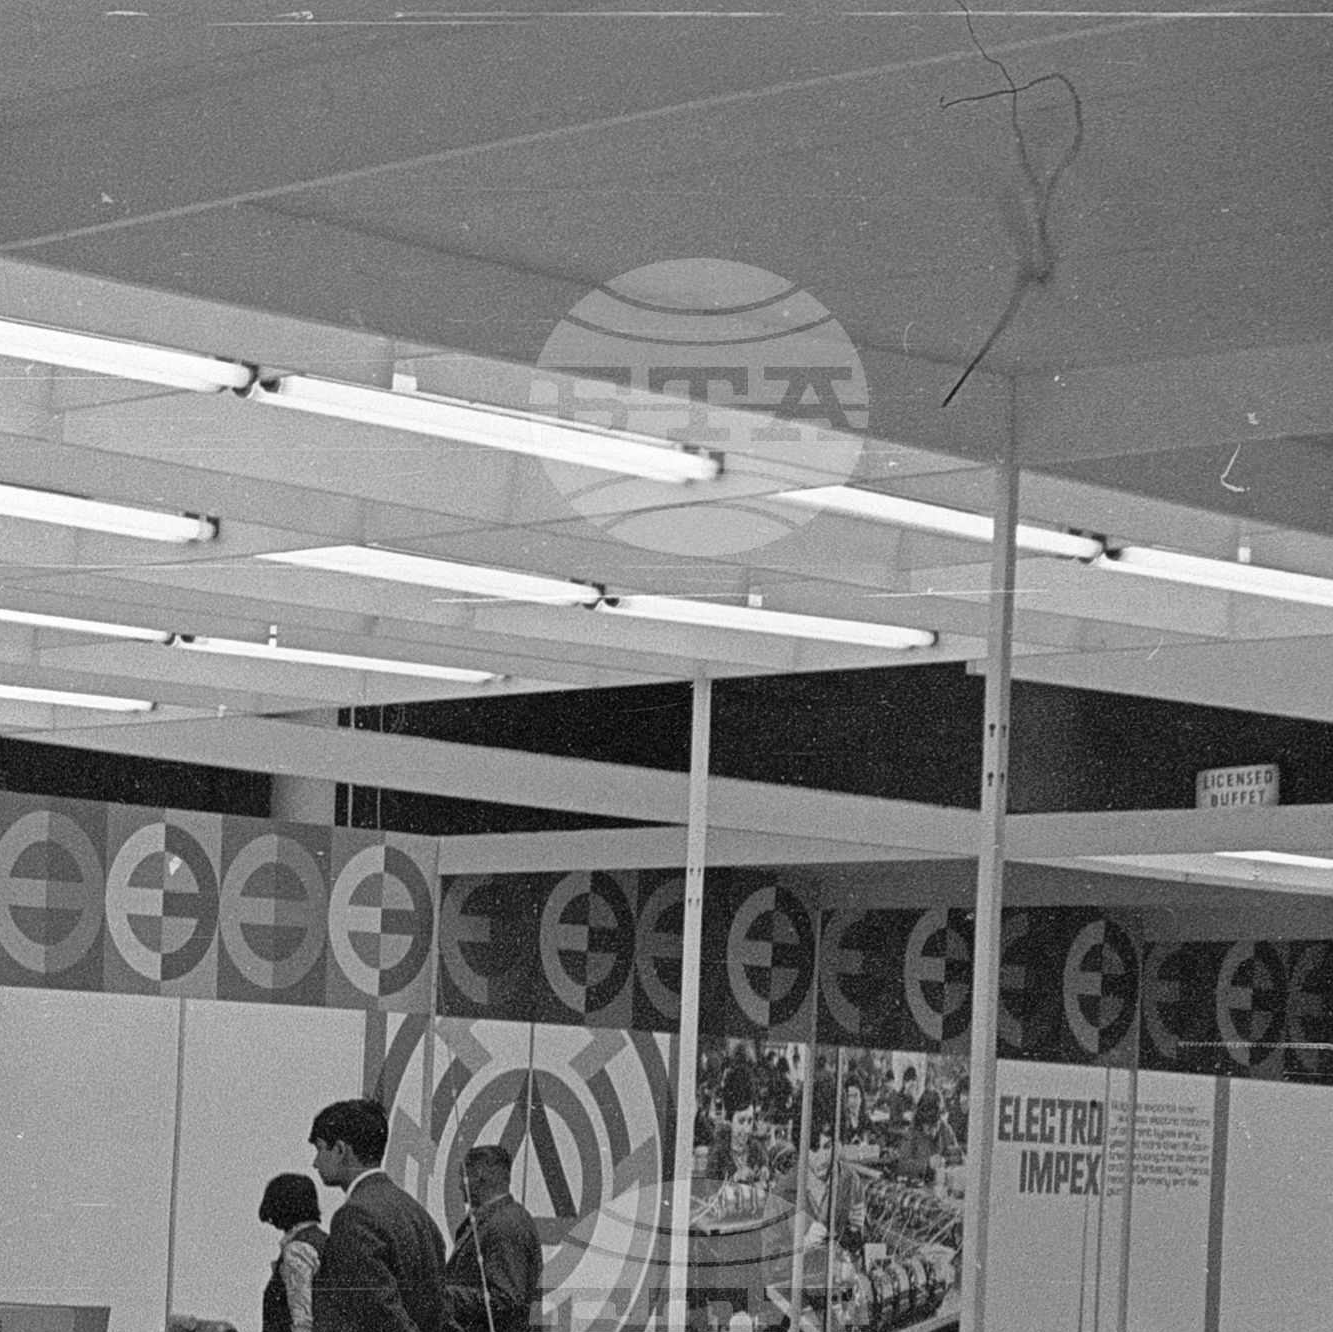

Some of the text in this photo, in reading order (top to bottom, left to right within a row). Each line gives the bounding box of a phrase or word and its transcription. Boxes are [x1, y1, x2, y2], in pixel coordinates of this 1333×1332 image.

[1203, 768, 1273, 790] LICENSED
[1210, 789, 1265, 808] BUFFET
[997, 1096, 1104, 1146] ELECTRO
[1019, 1149, 1102, 1195] IMPEX
